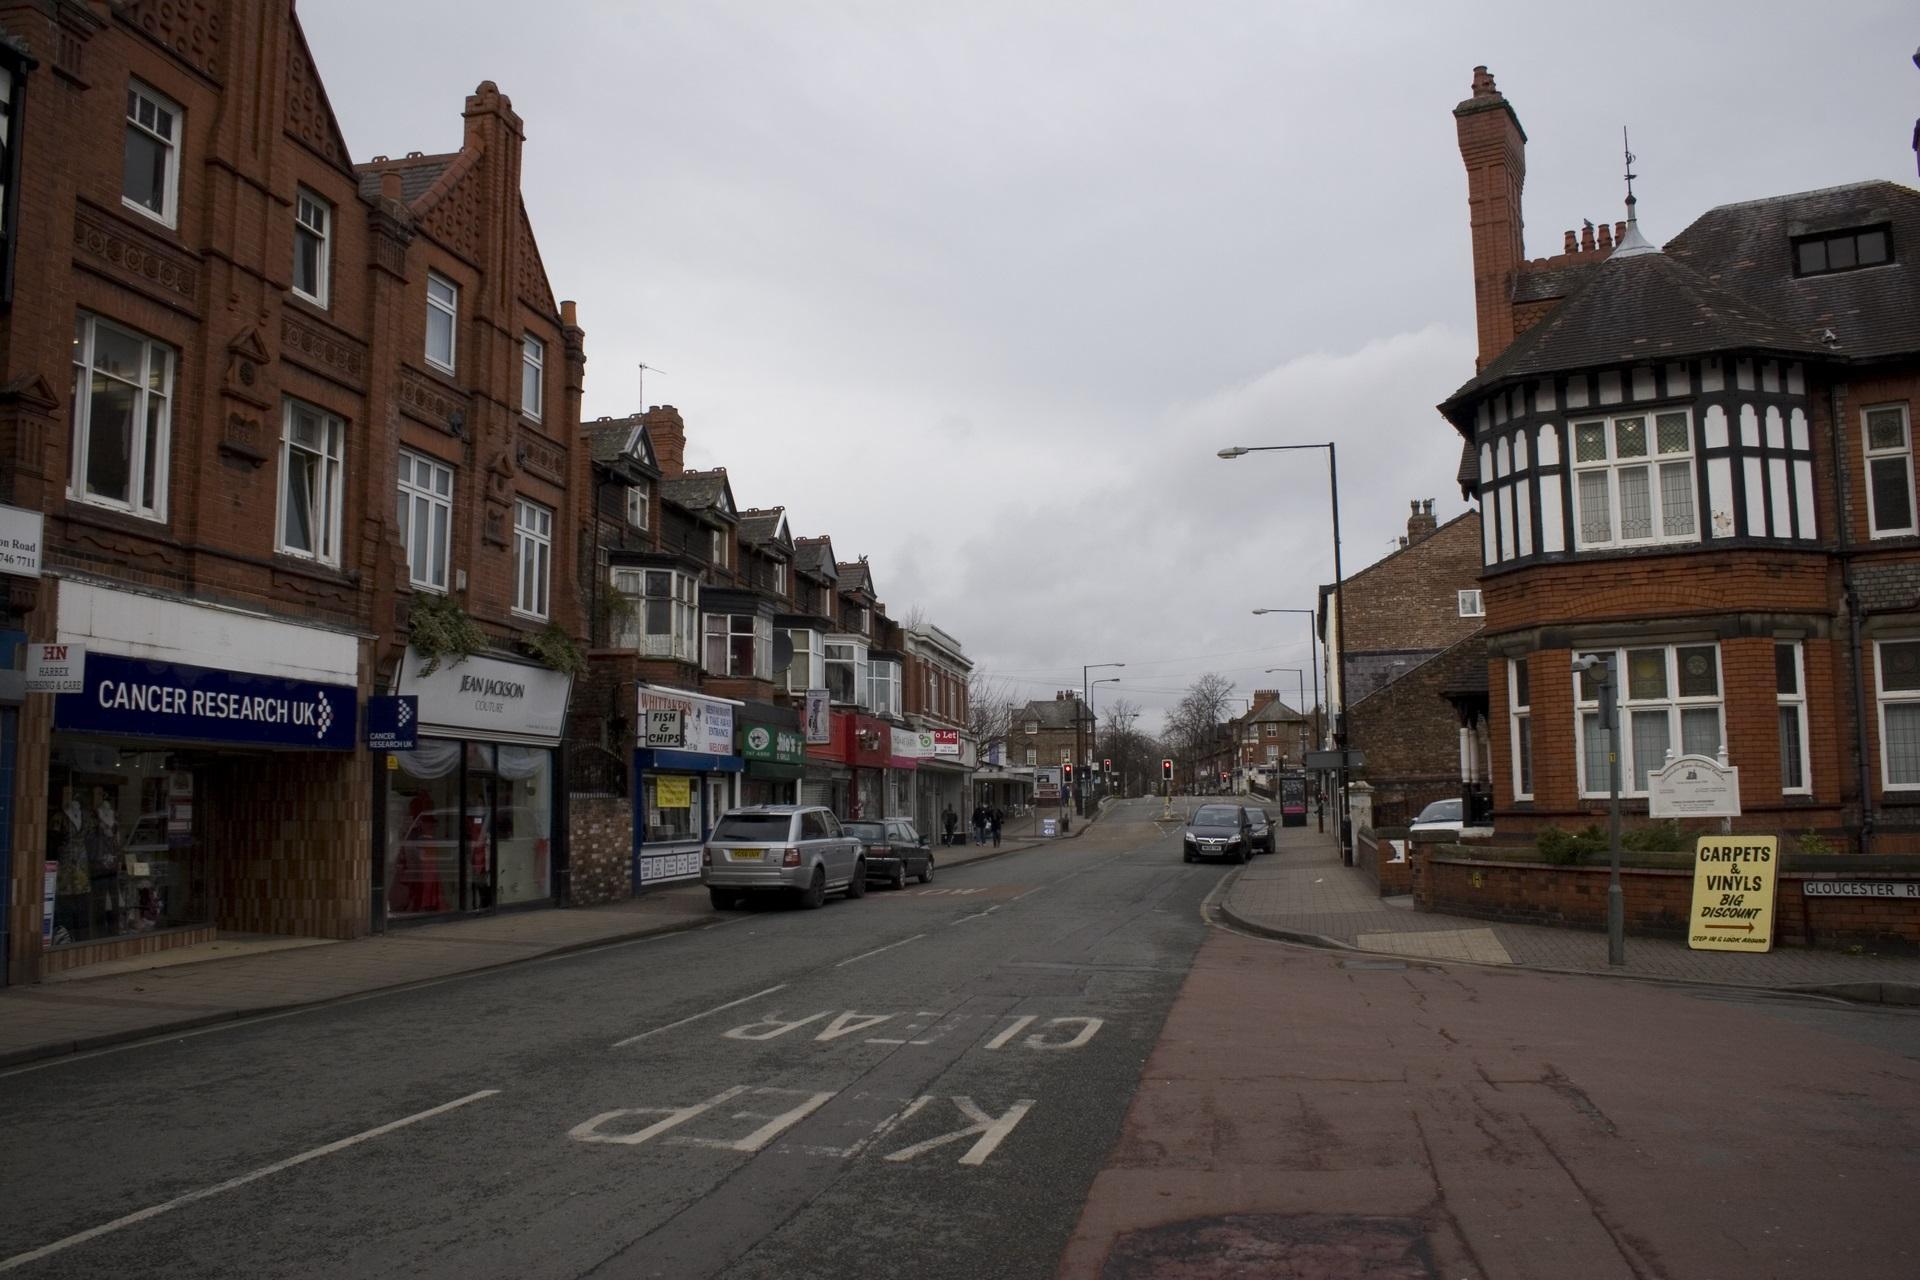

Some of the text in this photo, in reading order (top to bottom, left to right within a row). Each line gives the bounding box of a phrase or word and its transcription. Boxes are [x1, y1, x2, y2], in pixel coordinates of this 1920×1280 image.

[12, 539, 36, 552] Road
[16, 556, 36, 568] 7711
[42, 646, 69, 660] HN
[63, 680, 82, 690] CARE
[459, 674, 526, 698] JEAN JACKSON
[98, 679, 316, 726] CANCER RESEARCH UK
[474, 700, 504, 714] COUTURE
[641, 692, 693, 717] WHITTAKERS
[652, 712, 677, 722] FISH
[659, 723, 670, 733] &
[708, 726, 729, 738] ENTRANCE
[369, 732, 396, 740] CANCER
[648, 733, 680, 744] CHIPS
[942, 731, 957, 739] Let
[370, 740, 414, 748] RESEARCH UK
[708, 742, 730, 753] WELCOME
[1700, 846, 1771, 862] CARPETS
[1730, 863, 1741, 874] &
[1706, 875, 1763, 892] VINYLS
[1806, 882, 1895, 896] GLOUCESTER
[1719, 893, 1744, 907] BIG
[1701, 906, 1763, 920] DISCOUNT
[722, 1010, 1104, 1050] CLEAR
[567, 1085, 1038, 1166] KEEP
